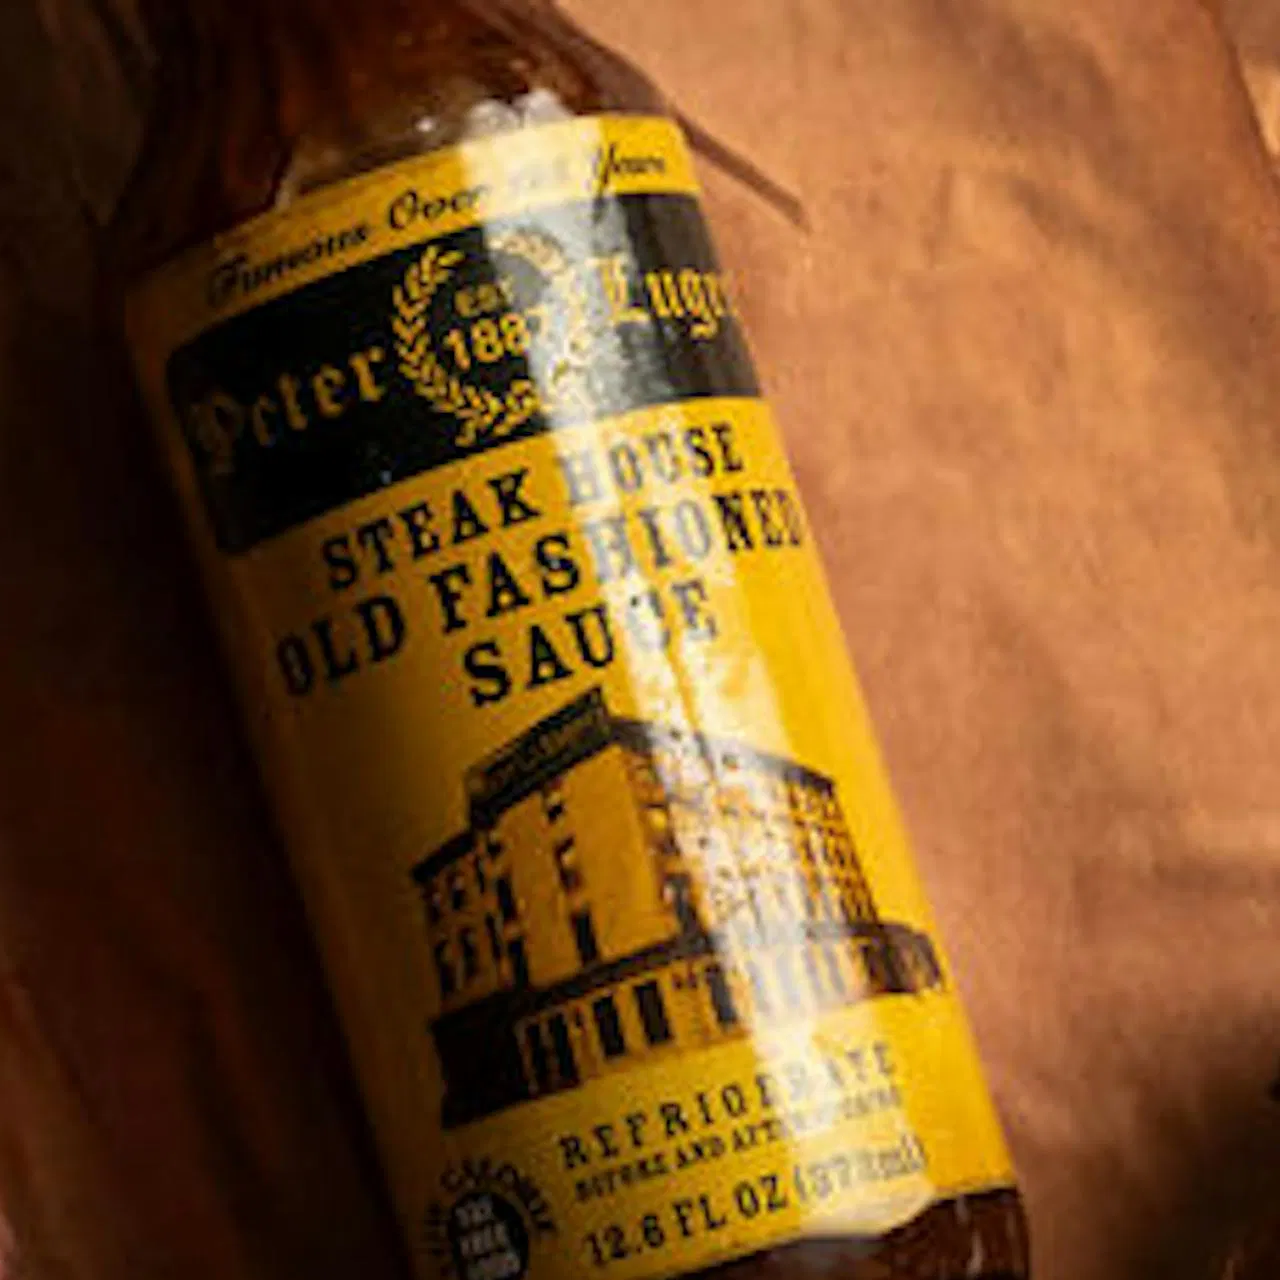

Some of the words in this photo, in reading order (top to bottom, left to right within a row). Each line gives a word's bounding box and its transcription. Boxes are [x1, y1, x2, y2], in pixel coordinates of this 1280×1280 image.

[386, 184, 493, 231] Over
[322, 468, 540, 591] STEAK
[556, 420, 742, 505] HOUSE
[276, 596, 405, 696] OLD
[428, 488, 802, 635] FASHIONED
[674, 1136, 727, 1169] AND
[583, 1212, 667, 1269] 12.6
[673, 1193, 728, 1240] FL
[732, 1173, 790, 1220] OZ
